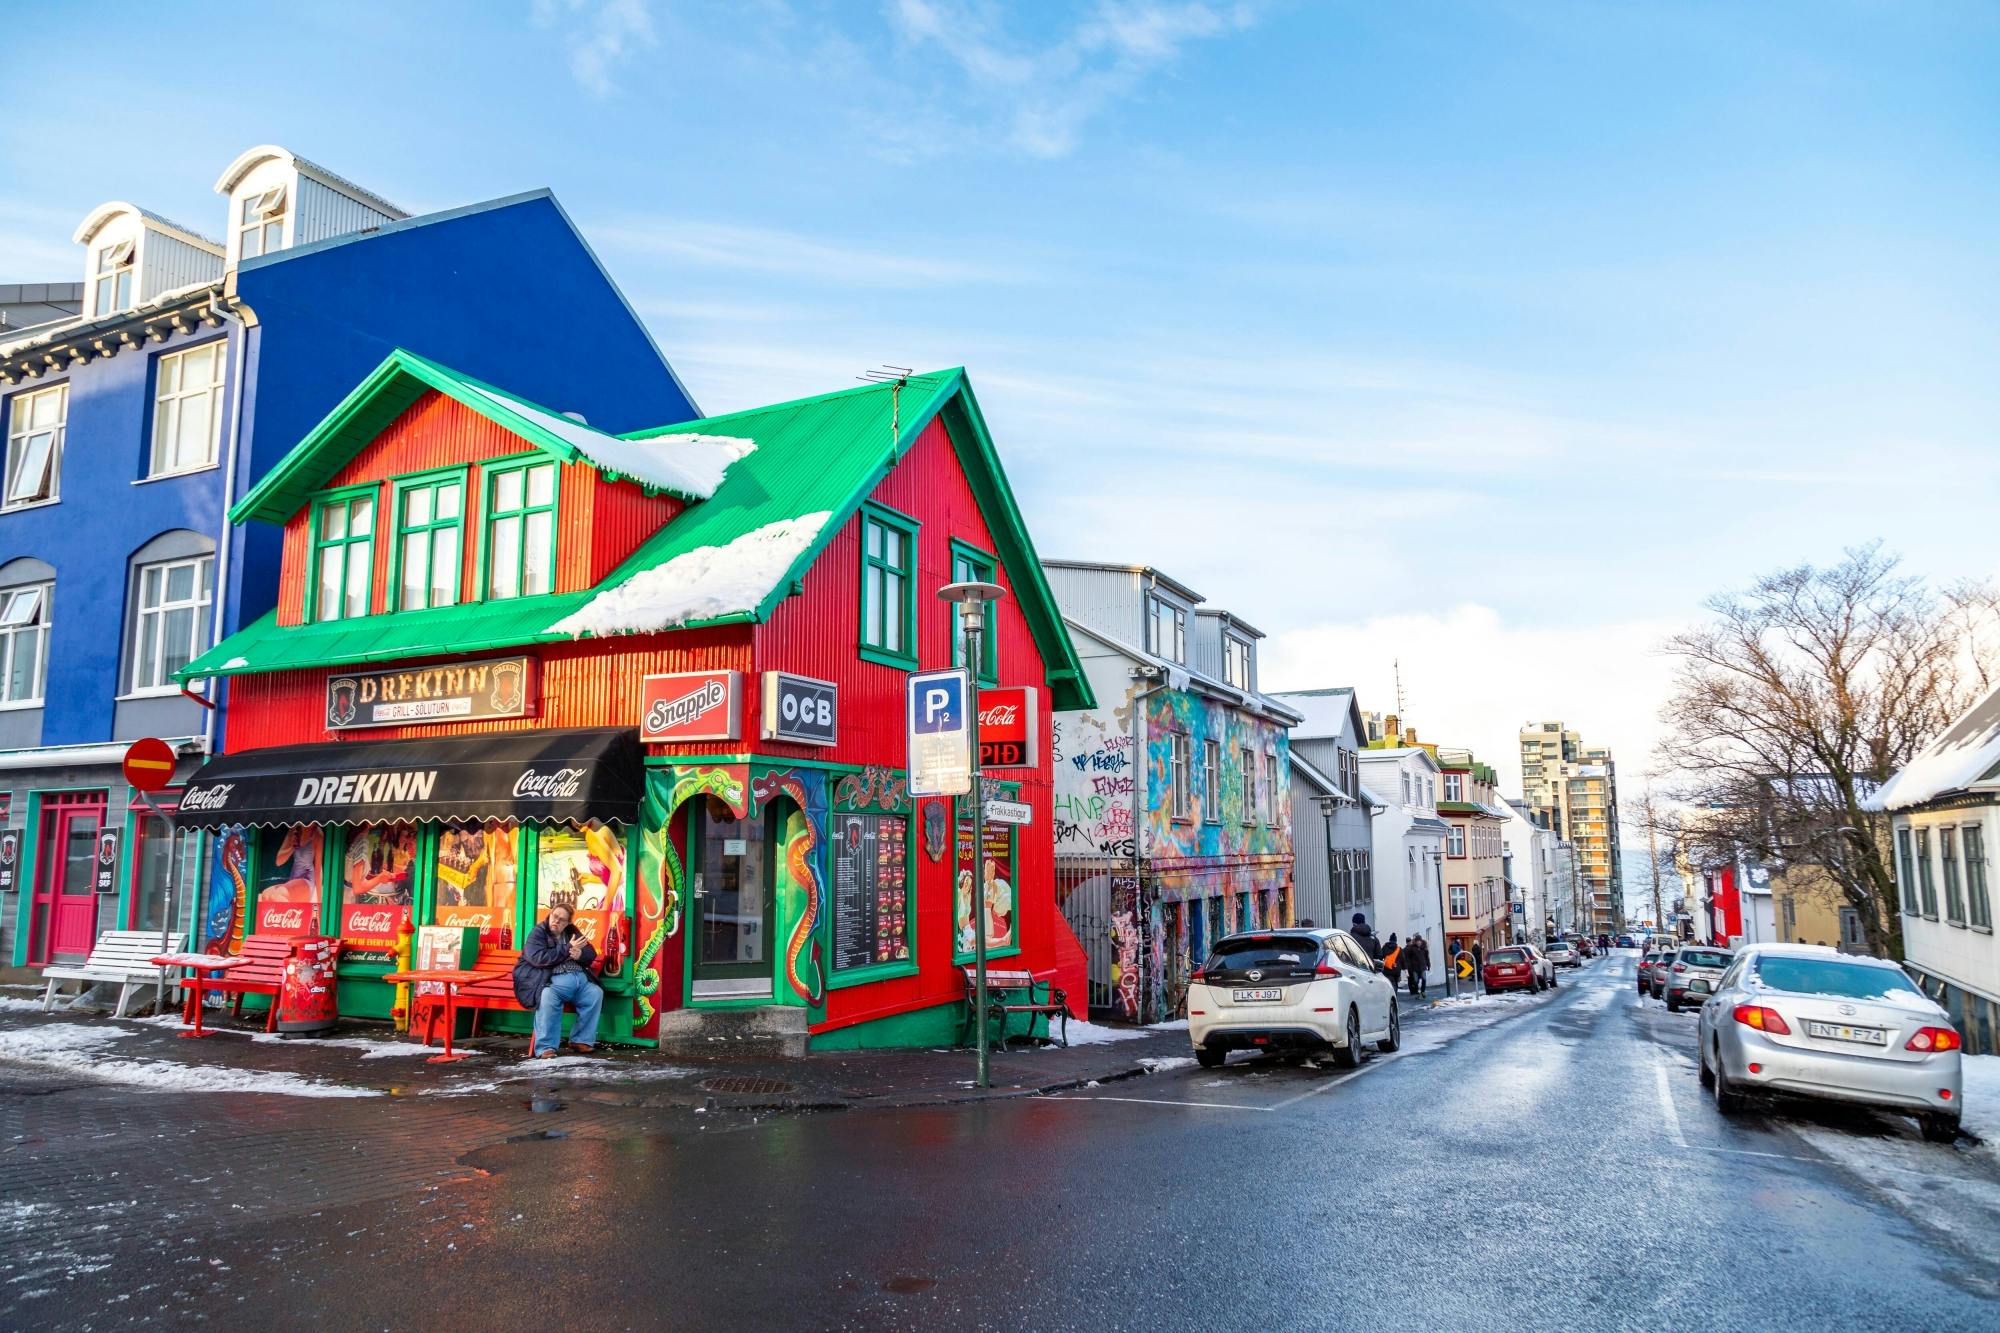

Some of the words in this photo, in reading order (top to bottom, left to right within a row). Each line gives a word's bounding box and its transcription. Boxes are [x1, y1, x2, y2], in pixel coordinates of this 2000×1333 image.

[360, 666, 489, 703] DREKINN
[649, 681, 721, 729] Snapple
[782, 693, 832, 727] OCB
[979, 705, 1019, 726] a-Cola
[980, 744, 1019, 764] PIÐ
[294, 771, 438, 806] DREKINN
[512, 768, 587, 797] Coca-Cola
[180, 784, 235, 810] Coca-Cola
[263, 909, 304, 929] Coca-Cola
[349, 911, 393, 932] Coca-Cola
[1241, 991, 1254, 999] LK
[1261, 991, 1278, 999] J97
[1820, 1023, 1840, 1036] NT
[1853, 1029, 1881, 1042] F74
